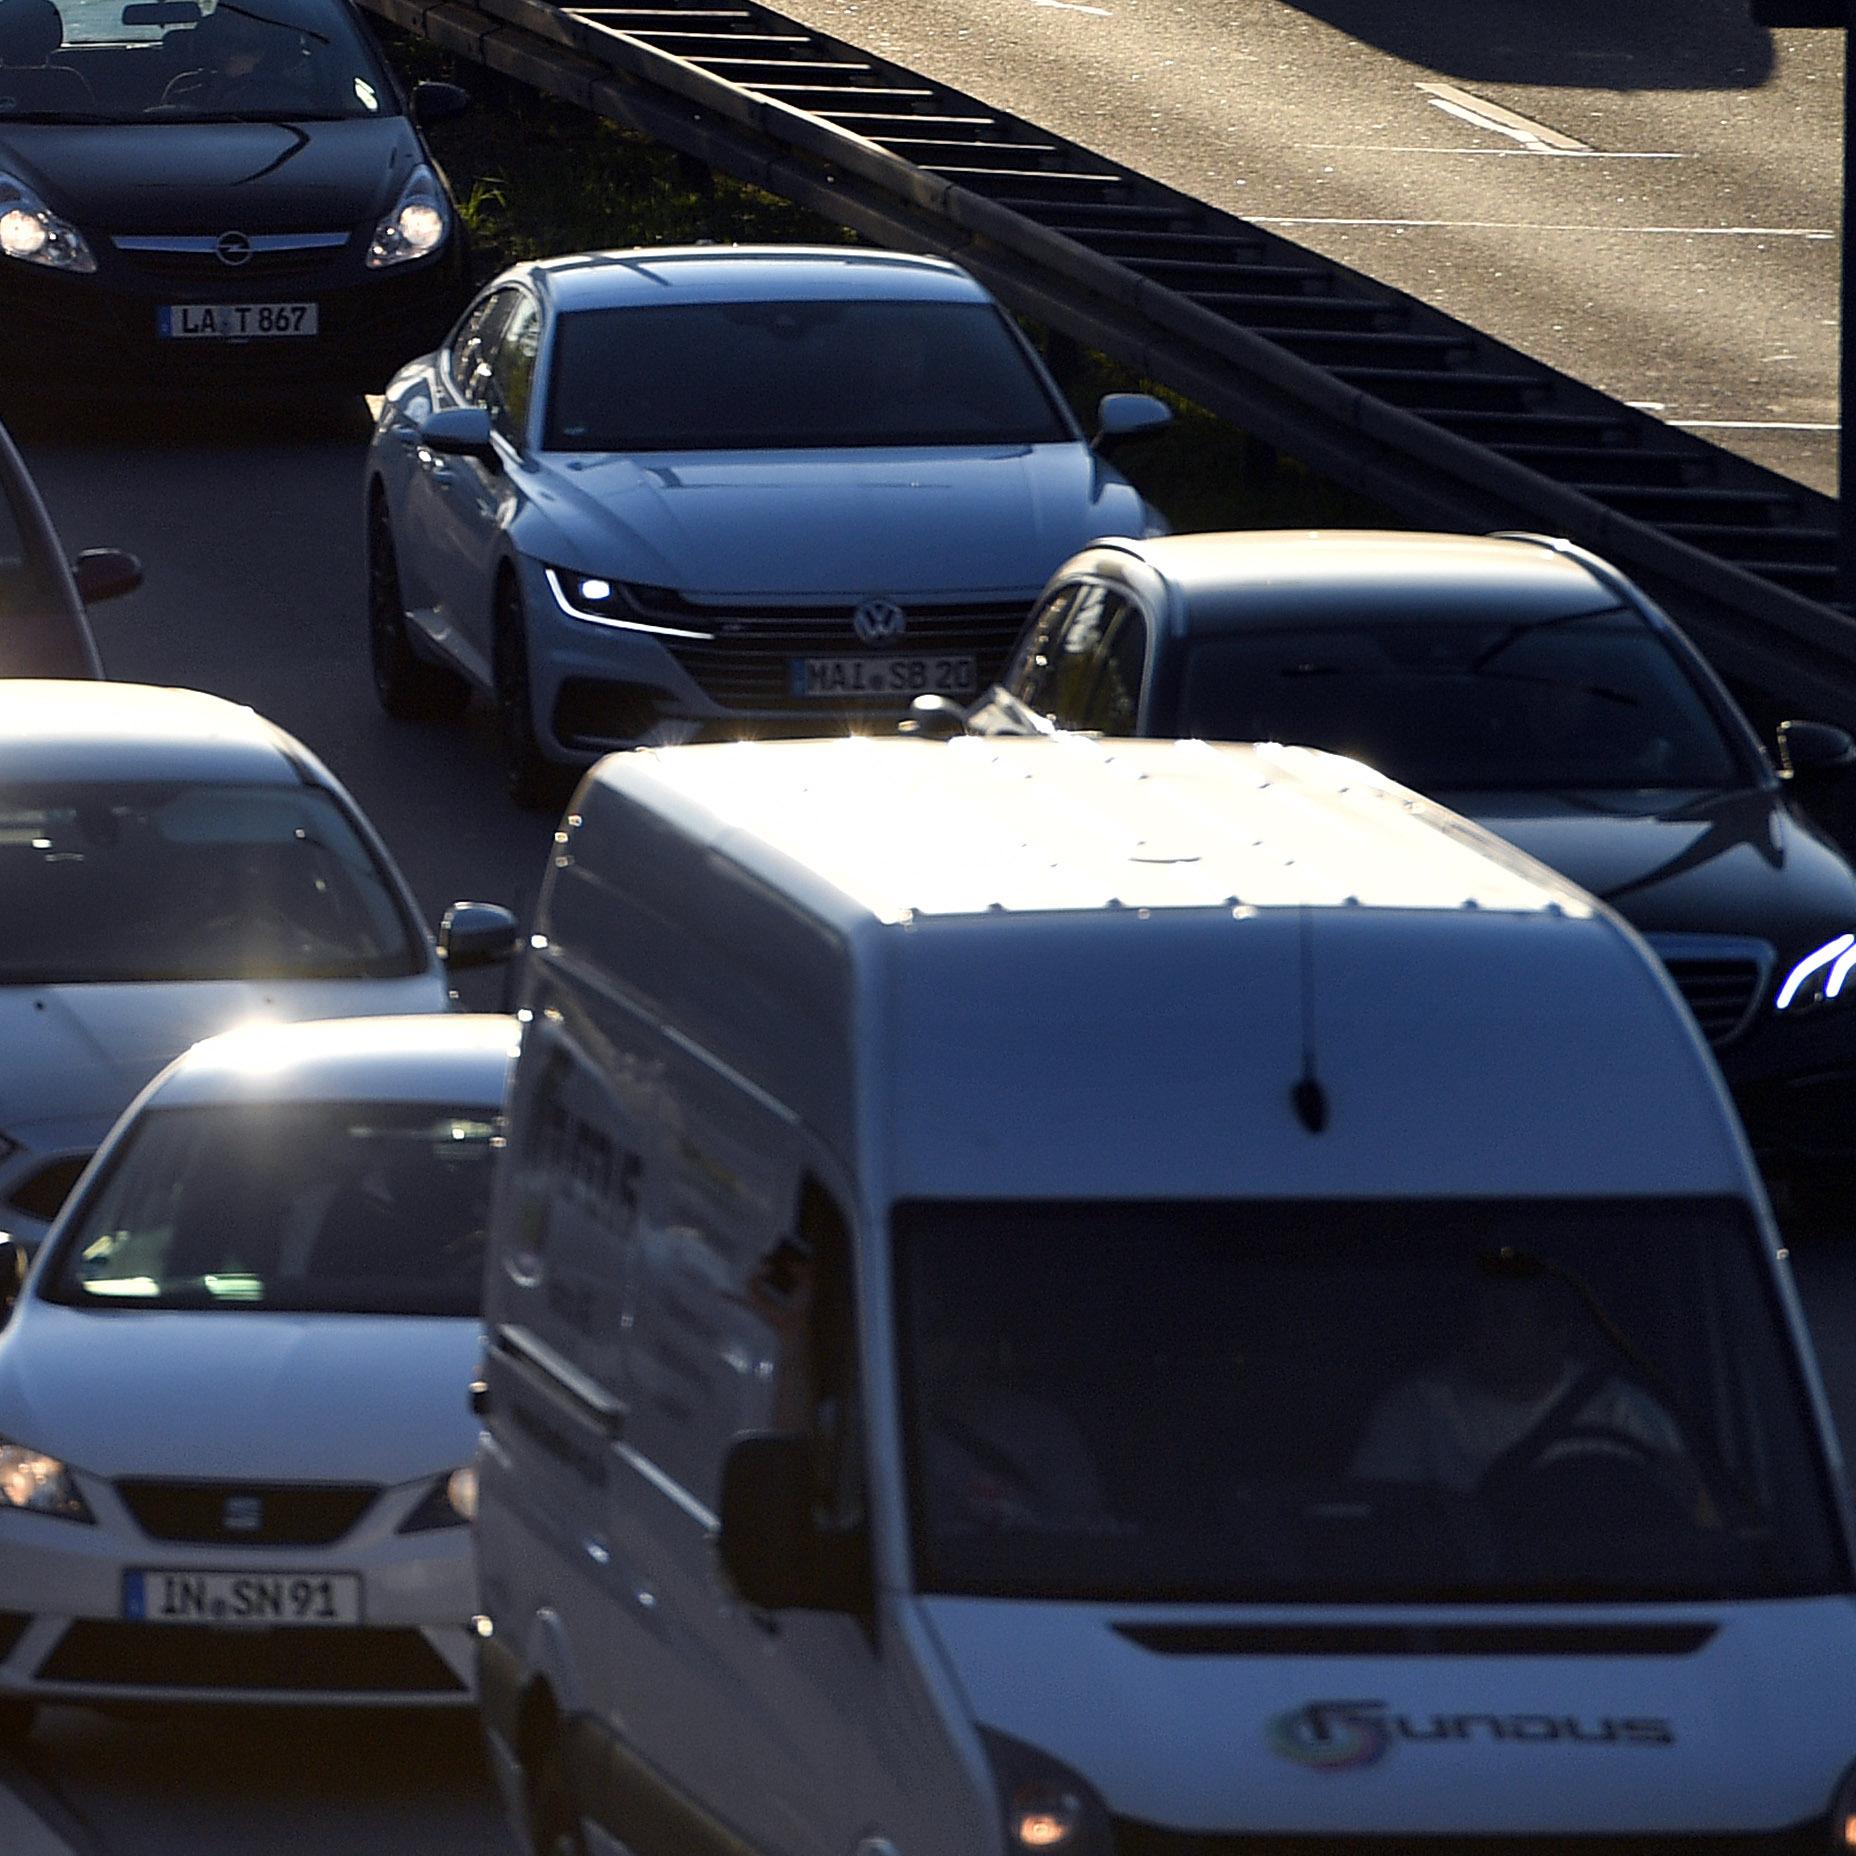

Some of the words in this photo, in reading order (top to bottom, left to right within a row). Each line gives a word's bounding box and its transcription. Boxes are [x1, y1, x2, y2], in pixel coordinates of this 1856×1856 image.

[182, 308, 215, 333] LA
[234, 307, 251, 332] T
[258, 306, 307, 332] 867
[891, 661, 926, 690] SB
[161, 1575, 206, 1615] IN
[231, 1578, 283, 1617] SN
[289, 1578, 337, 1617] 91
